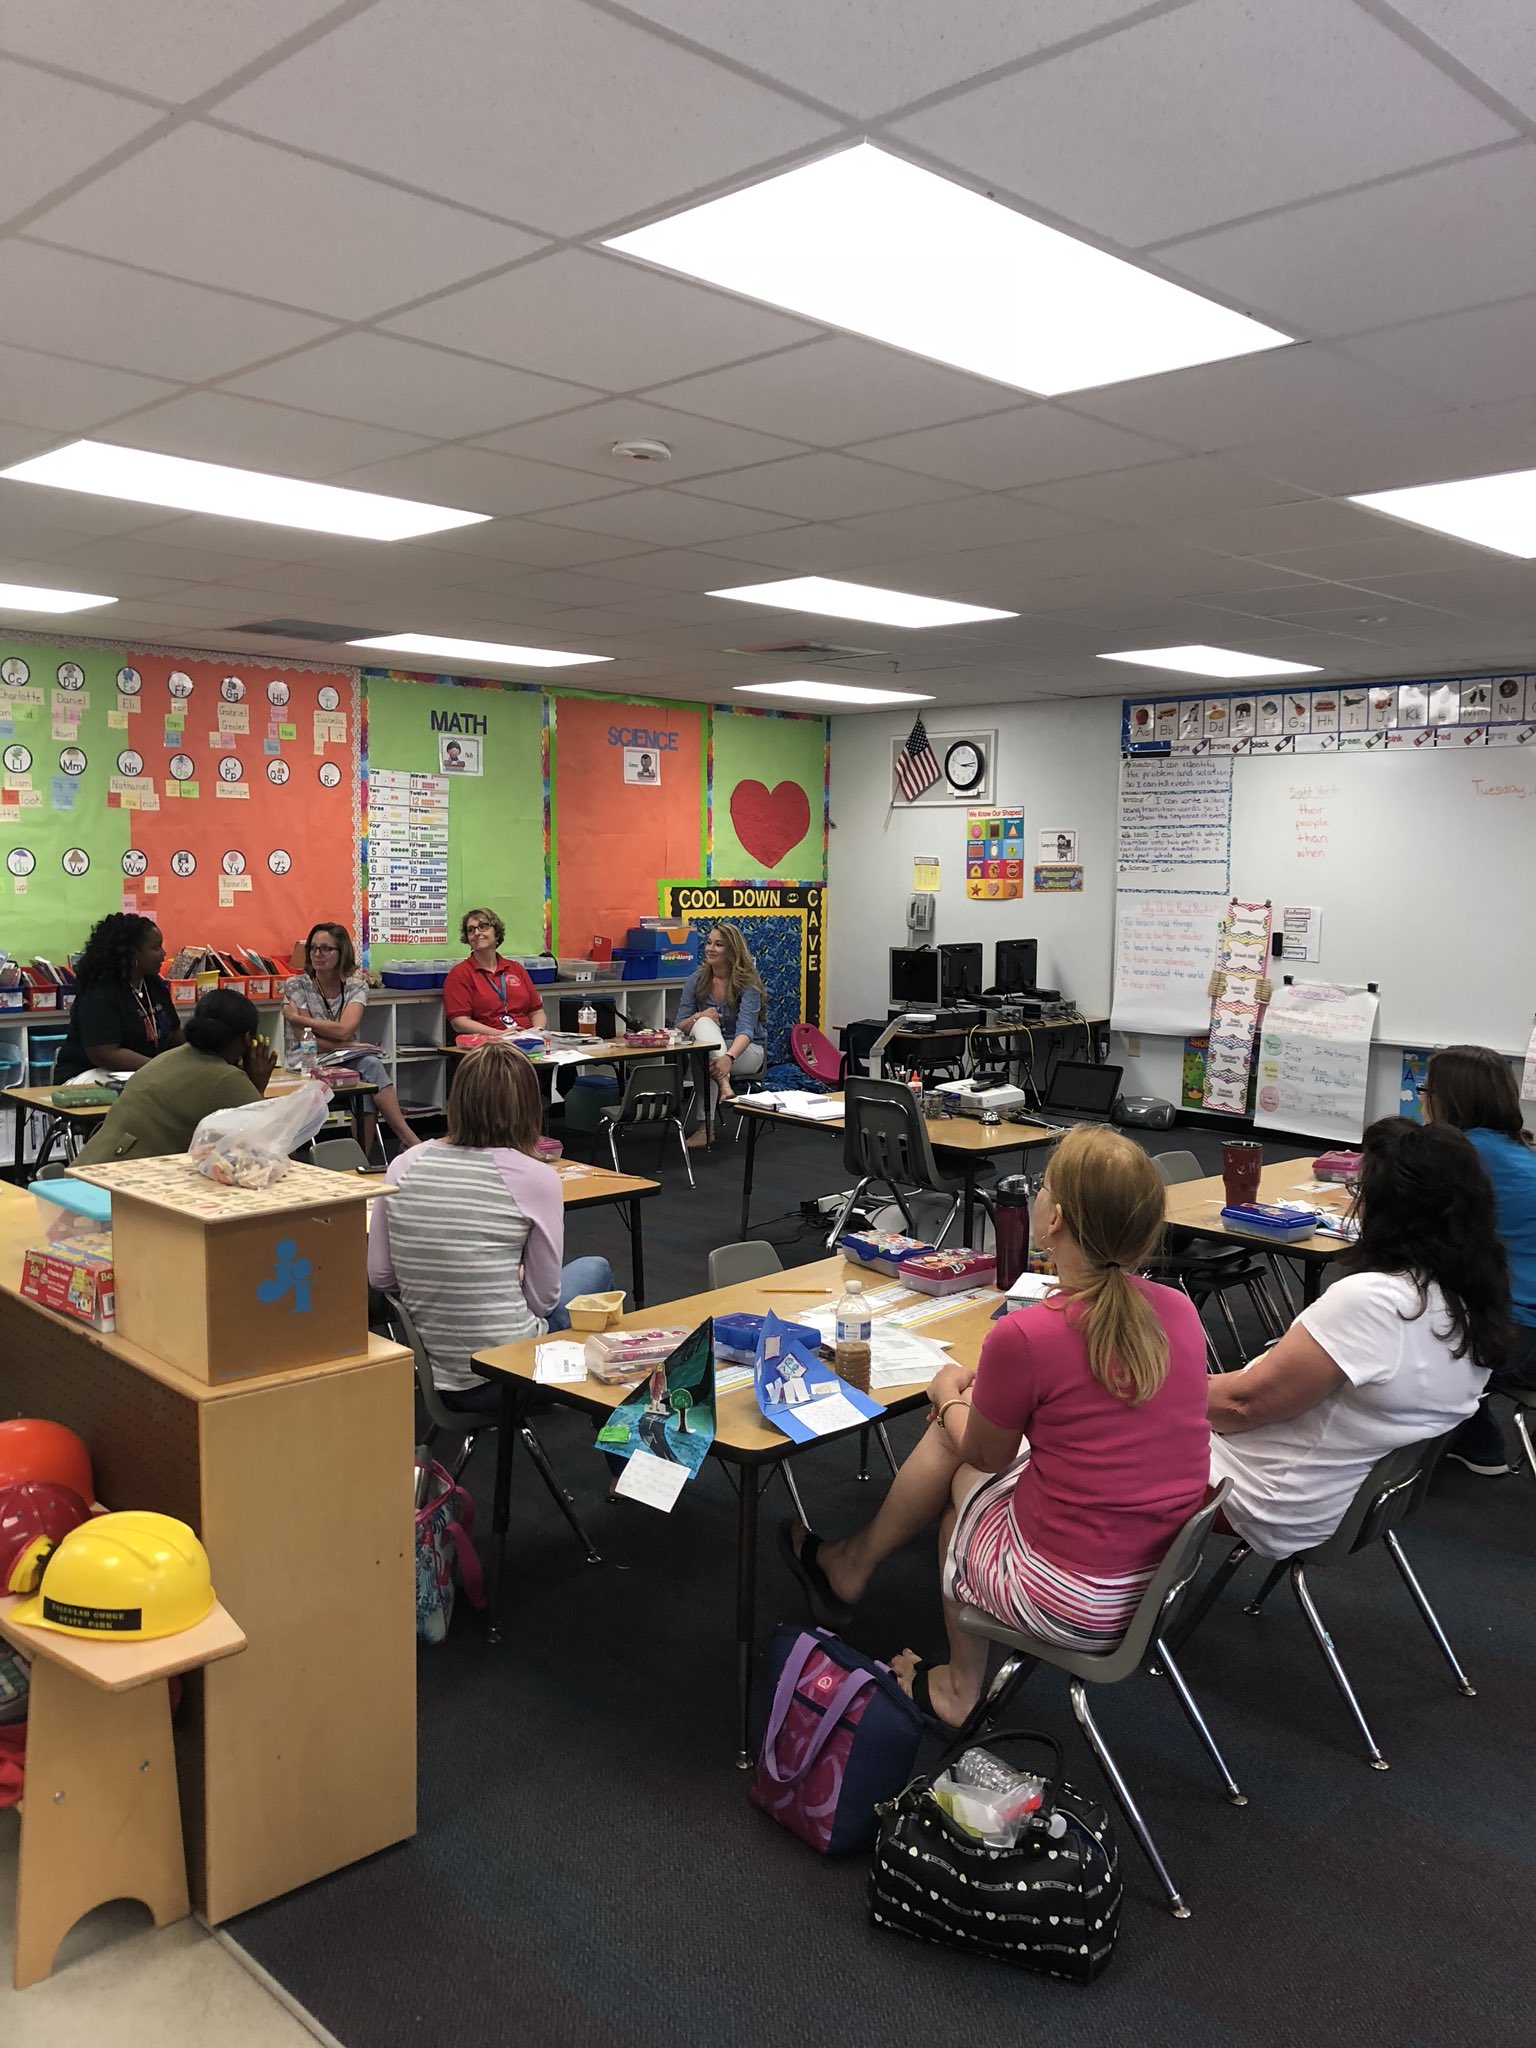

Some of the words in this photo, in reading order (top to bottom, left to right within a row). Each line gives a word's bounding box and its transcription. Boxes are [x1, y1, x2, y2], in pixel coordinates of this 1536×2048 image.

[8, 673, 22, 684] Cc
[63, 677, 78, 688] Dd
[174, 685, 187, 695] Ff
[226, 688, 239, 700] Gg
[272, 693, 284, 703] Hh
[1499, 703, 1517, 715] Nn
[1317, 714, 1333, 727] Hh
[1405, 709, 1421, 721] Kk
[431, 710, 487, 735] MATH
[1209, 722, 1224, 733] Dd
[1288, 717, 1305, 732] Gg
[1135, 727, 1150, 737] Aa
[1160, 724, 1174, 736] Bb
[607, 726, 680, 751] SCIENCE
[1339, 737, 1361, 746] green
[1437, 732, 1451, 740] red
[1251, 739, 1269, 749] black
[63, 760, 82, 770] Mm
[124, 763, 138, 773] Nn
[225, 769, 237, 780] Pp
[270, 770, 284, 783] Qq
[324, 775, 335, 784] Rr
[1002, 809, 1023, 817] Shapes!
[69, 862, 82, 872] Vv
[125, 862, 143, 872] Ww
[178, 863, 189, 873] Xx
[228, 863, 239, 875] Yy
[274, 862, 286, 872] Zz
[678, 889, 726, 909] COOL
[733, 890, 780, 907] DOWN
[1195, 1051, 1205, 1063] A
[1403, 1069, 1416, 1082] A
[88, 1621, 113, 1629] PARK
